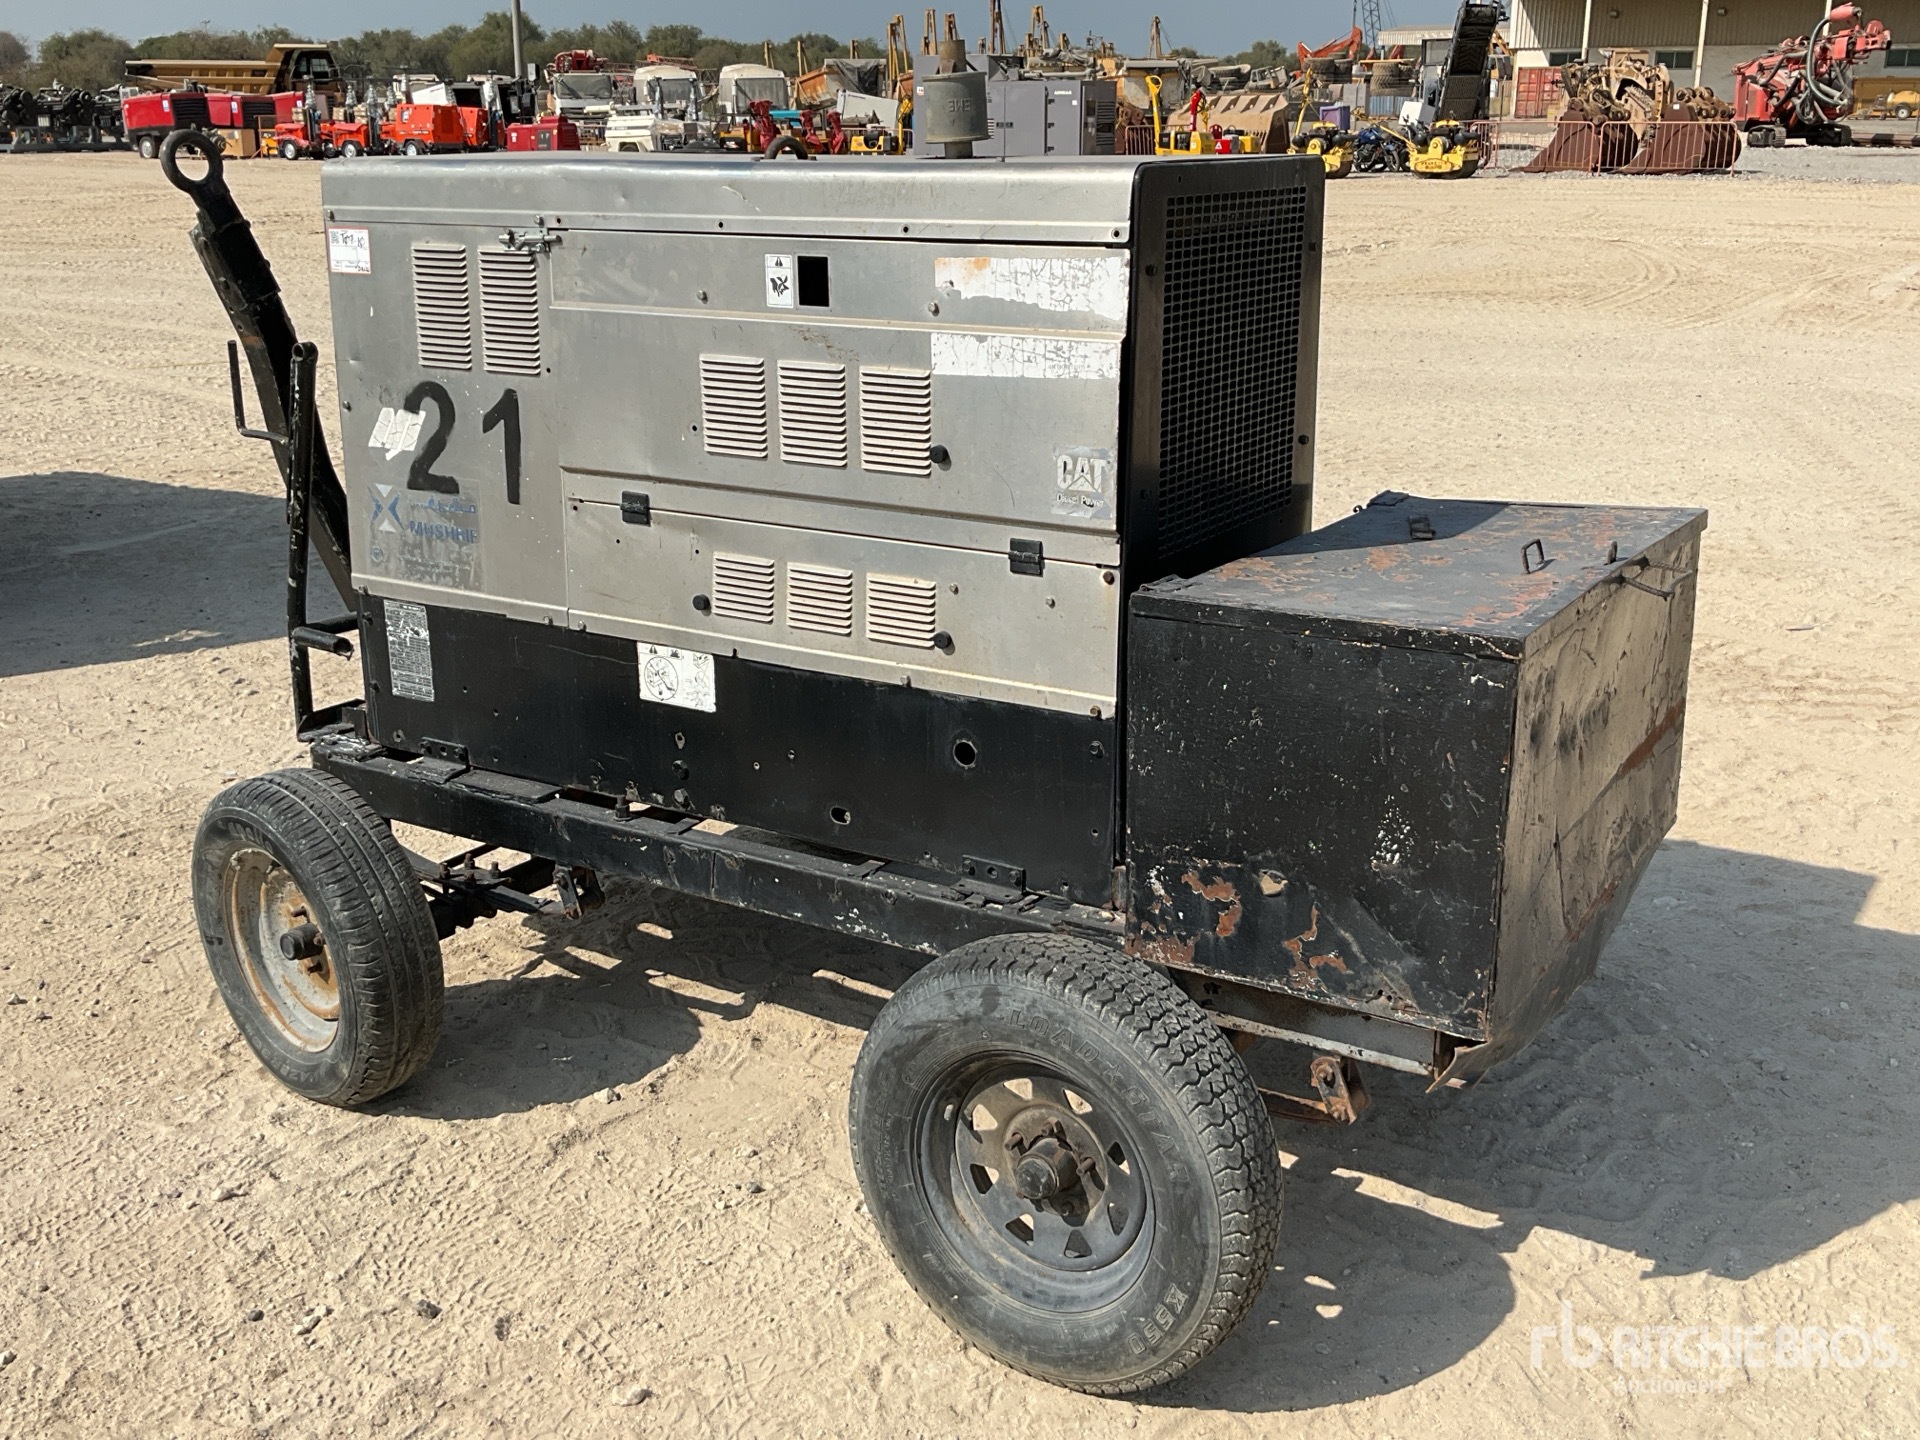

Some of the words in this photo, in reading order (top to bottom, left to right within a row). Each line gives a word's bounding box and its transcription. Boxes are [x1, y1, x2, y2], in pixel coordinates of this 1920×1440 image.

[403, 380, 521, 505] 21
[1056, 454, 1107, 493] CAT
[408, 520, 478, 544] MUSHRIF
[1126, 1282, 1189, 1355] K550
